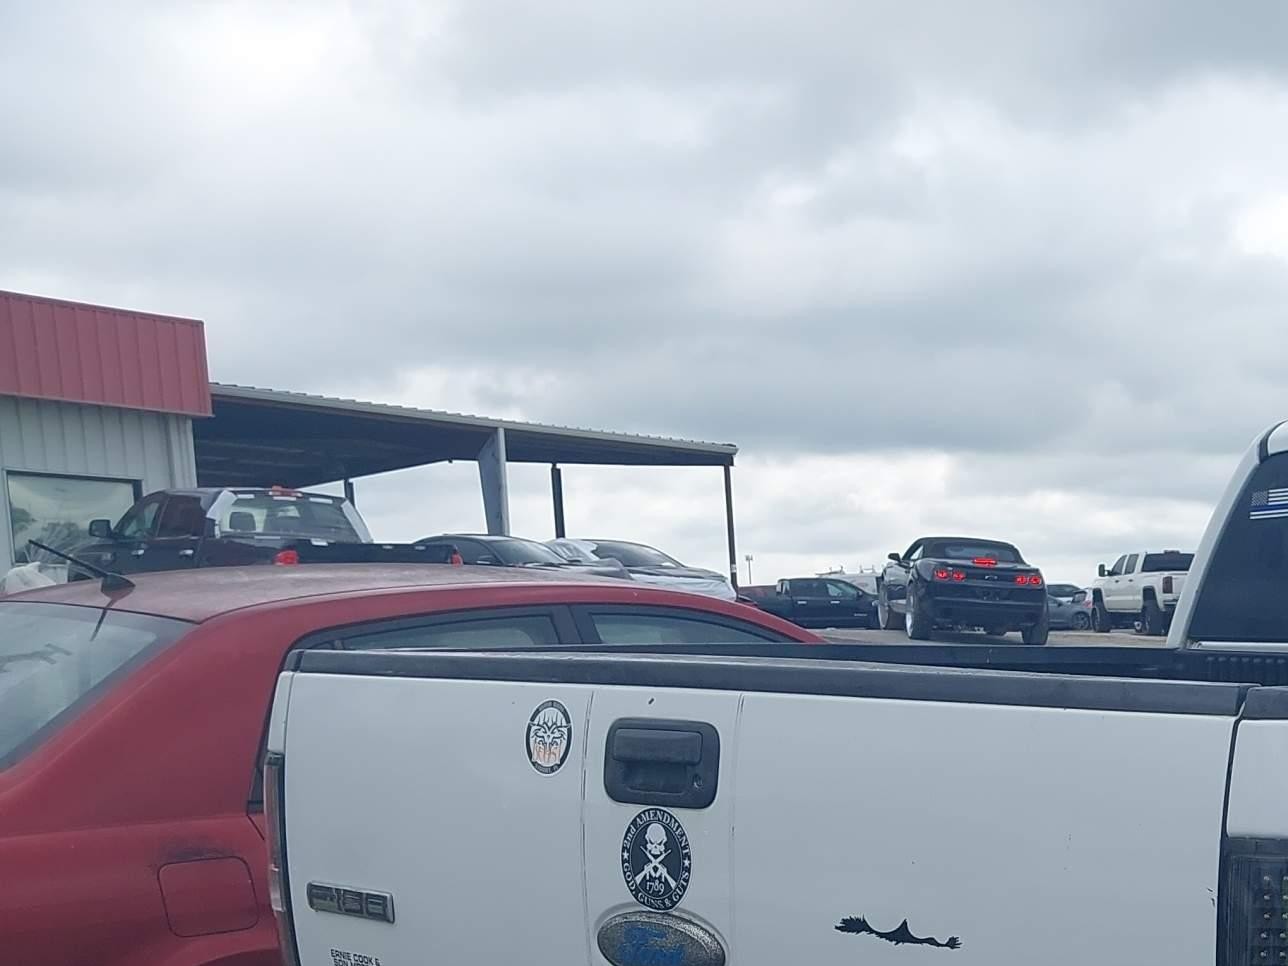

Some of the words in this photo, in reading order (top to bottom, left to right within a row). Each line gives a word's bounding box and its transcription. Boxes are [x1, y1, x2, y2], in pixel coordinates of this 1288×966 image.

[623, 826, 635, 850] 2nd
[635, 809, 691, 859] AMENDMENT
[622, 862, 636, 895] GOD,
[637, 893, 663, 909] GUNS
[664, 898, 673, 908] &
[672, 871, 690, 901] GUTS
[646, 881, 665, 896] 1789
[330, 949, 352, 961] ERNIE
[353, 953, 374, 965] COOK
